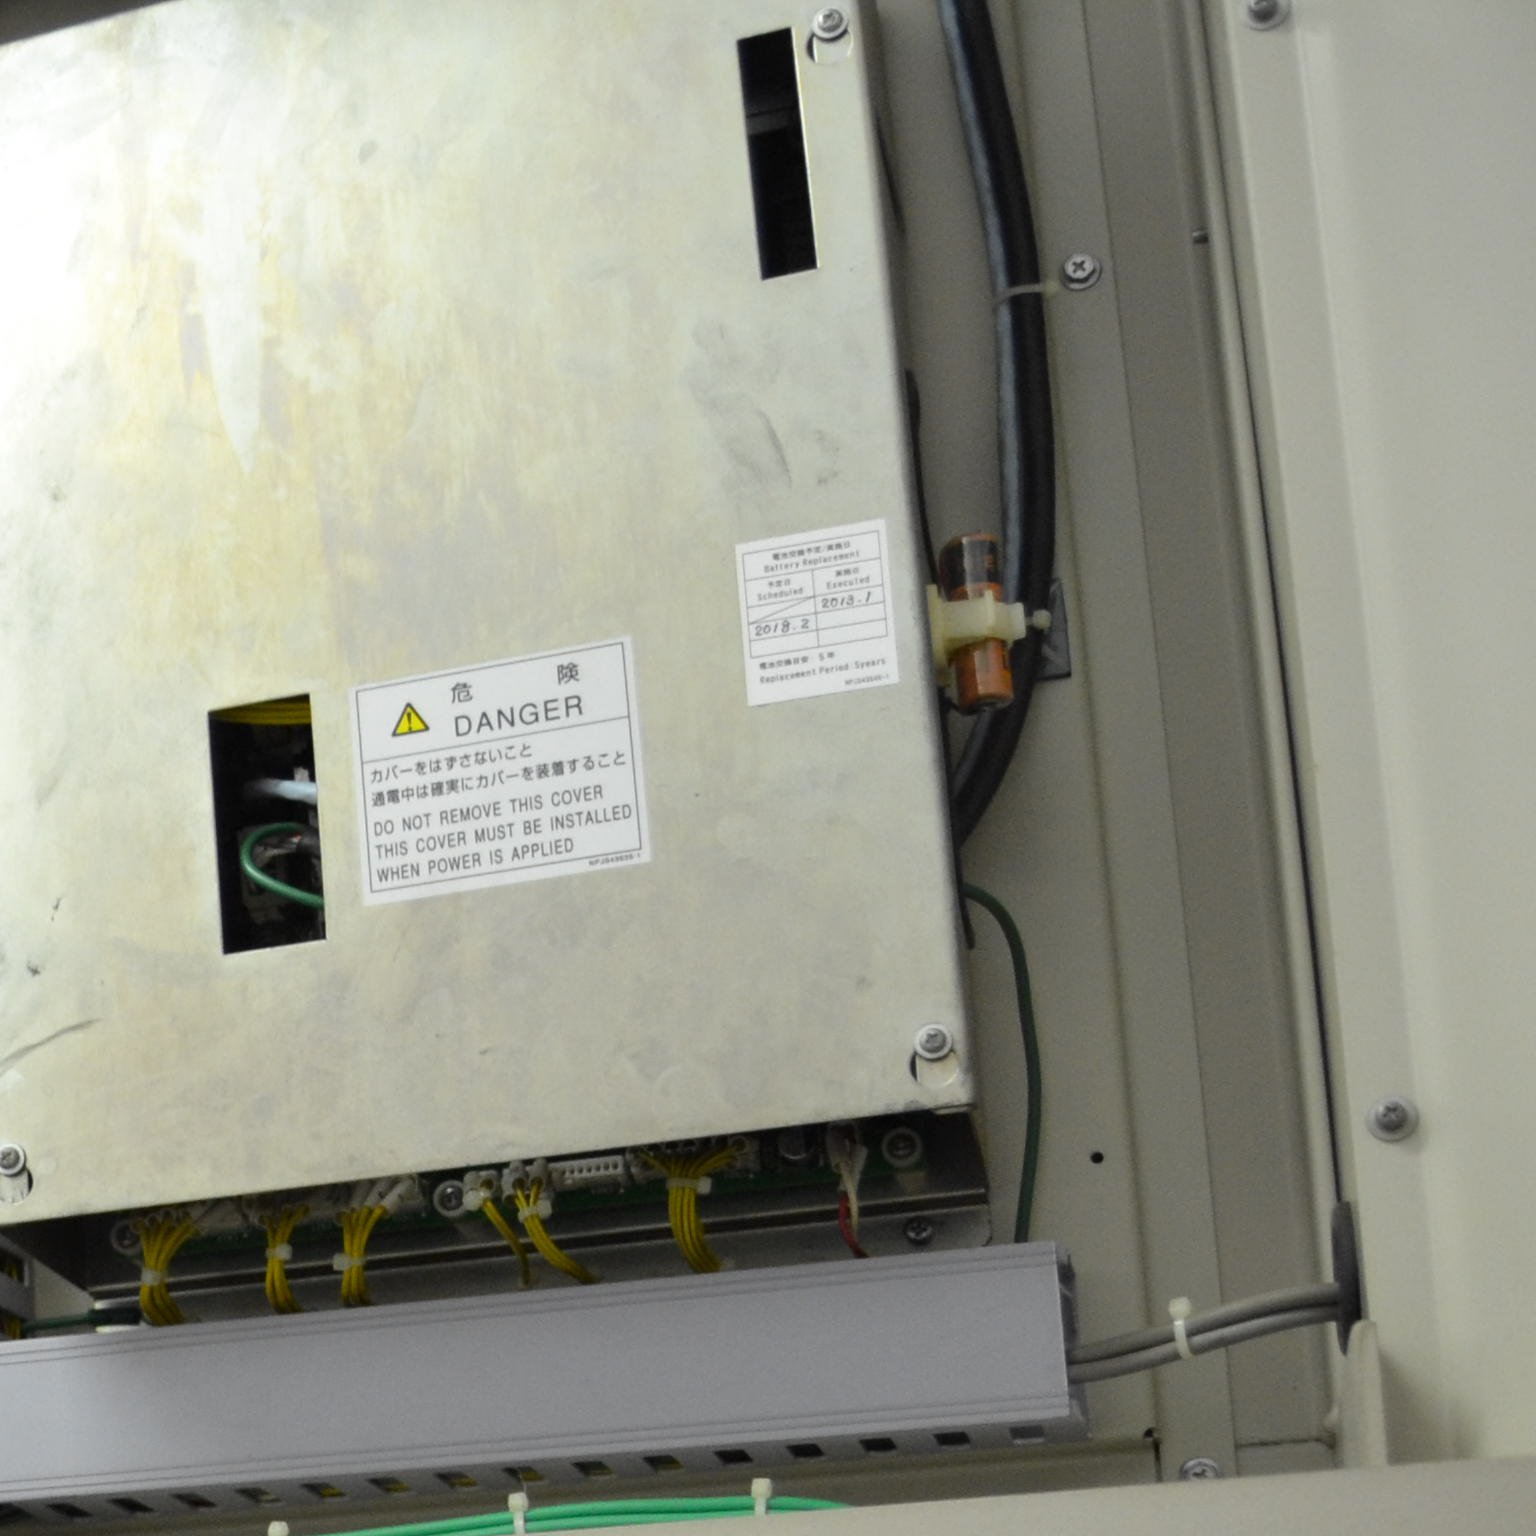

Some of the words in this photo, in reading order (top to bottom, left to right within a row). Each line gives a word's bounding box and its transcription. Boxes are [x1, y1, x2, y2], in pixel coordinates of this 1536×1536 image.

[454, 695, 584, 737] DANGER
[371, 744, 533, 783] カバーをはずさないこと
[374, 820, 394, 836] DO
[402, 813, 432, 833] NOT
[440, 801, 502, 827] REMOVE
[509, 795, 543, 814] THIS
[551, 785, 604, 807] COVER
[375, 841, 408, 860] THIS
[416, 831, 466, 854] COVER
[474, 824, 514, 843] MUST
[523, 818, 543, 835] BE
[551, 804, 632, 830] INSTALLED
[377, 861, 421, 883] WHEN
[428, 852, 482, 874] POWER
[489, 848, 503, 864] IS
[512, 838, 575, 861] APPLIED
